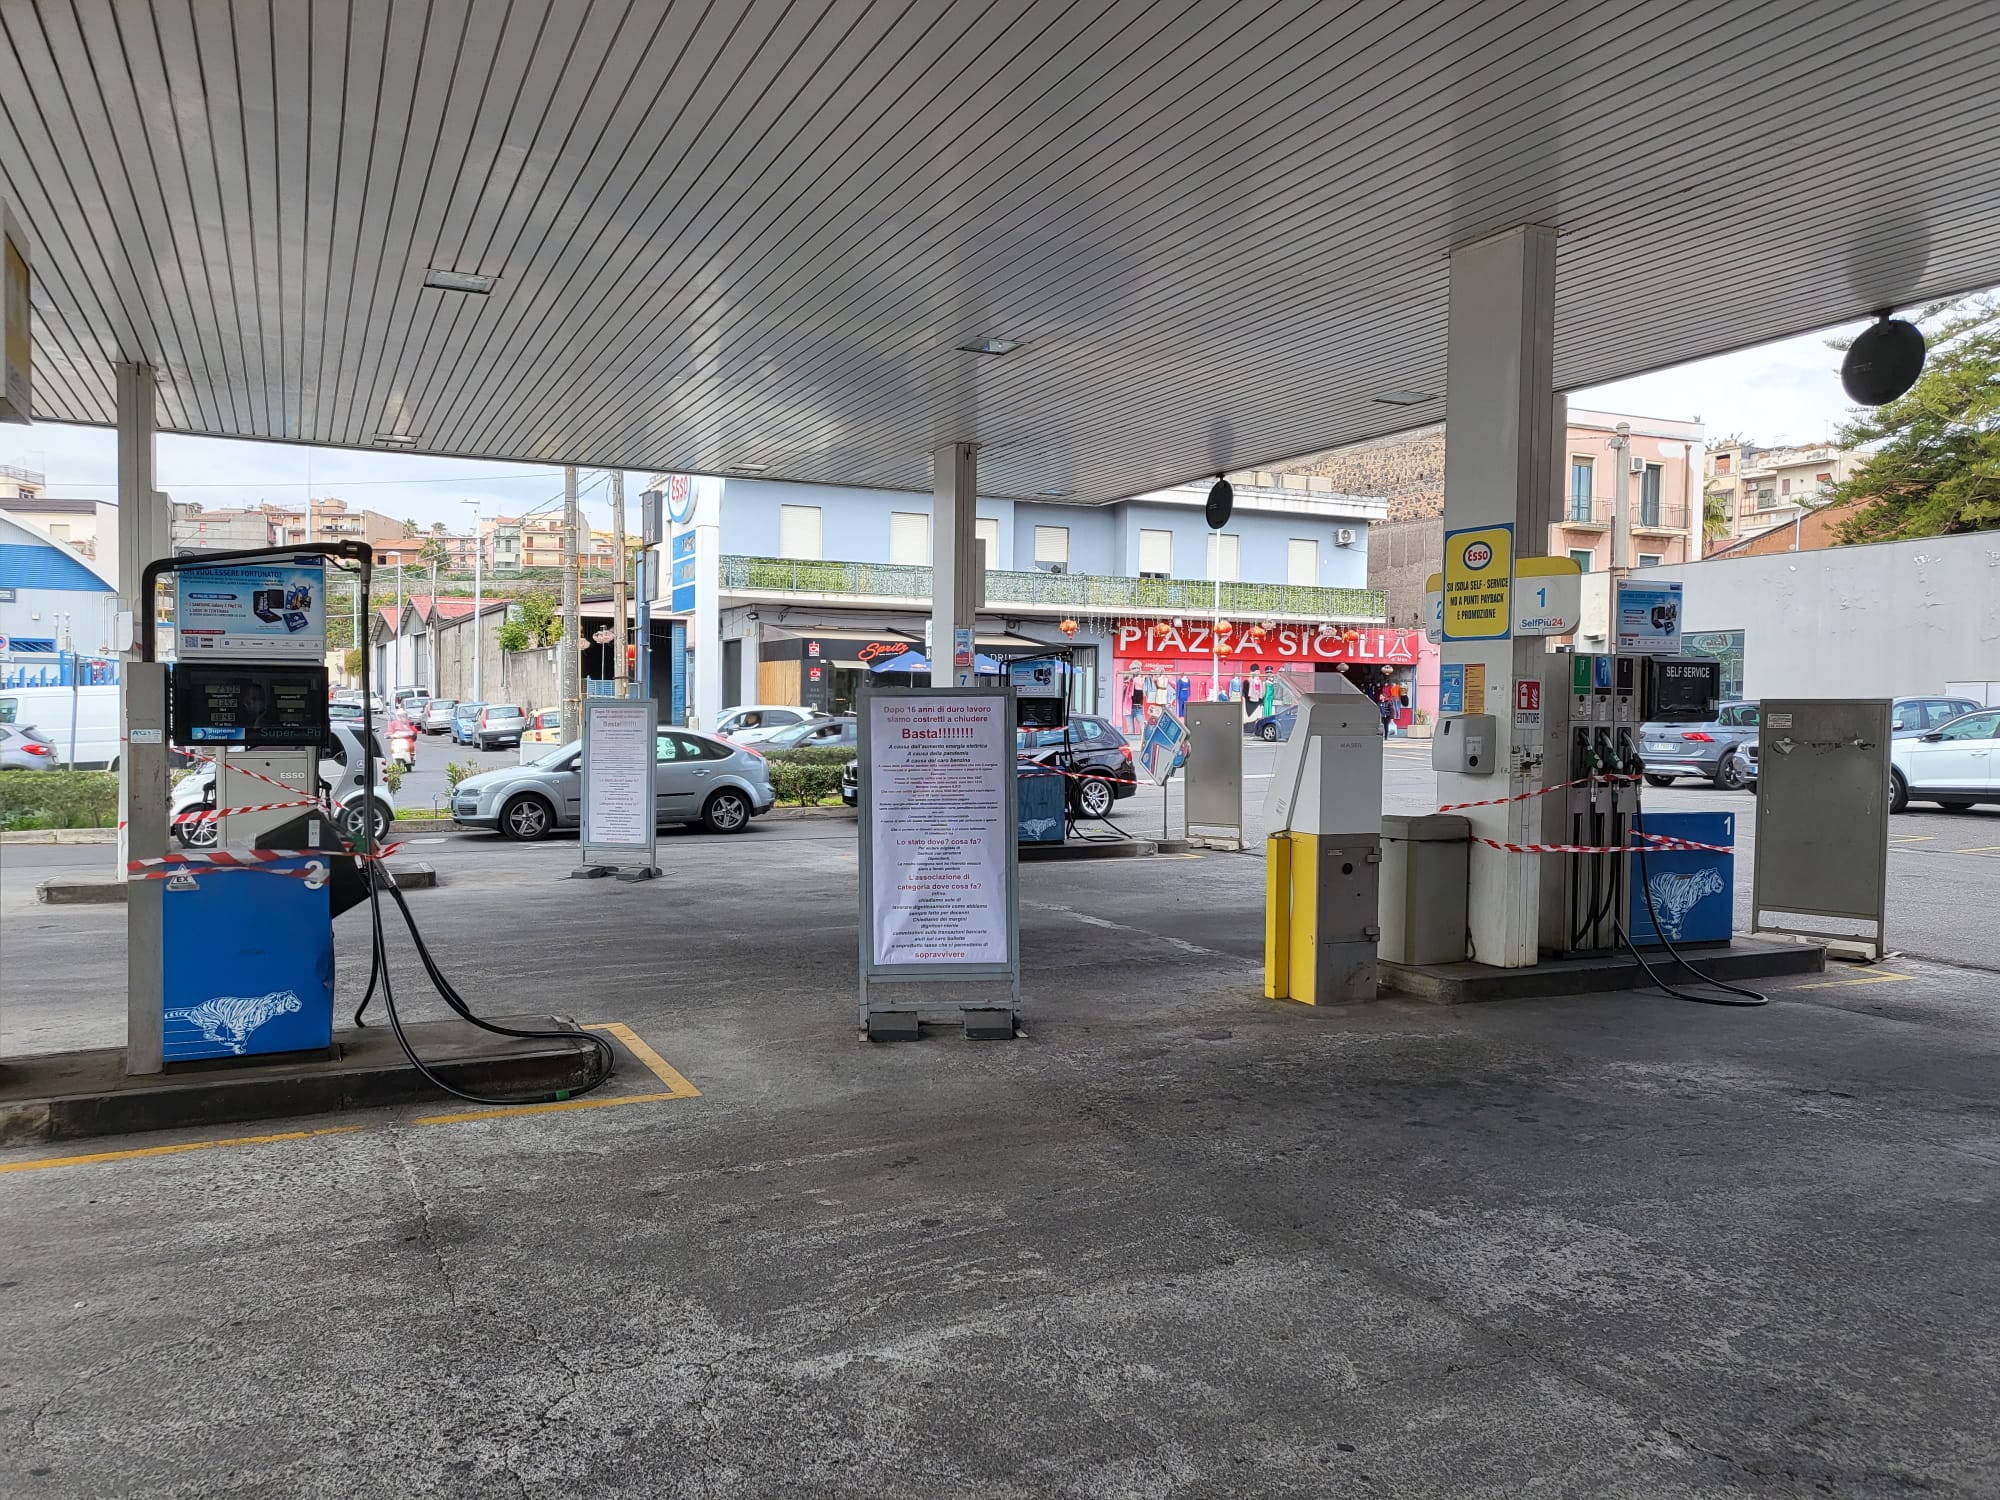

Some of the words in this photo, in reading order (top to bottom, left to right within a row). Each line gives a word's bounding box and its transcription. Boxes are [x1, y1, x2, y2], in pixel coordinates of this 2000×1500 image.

[1468, 550, 1488, 562] Esso
[1446, 582, 1454, 592] SU
[1454, 580, 1469, 592] ISOLA
[1470, 580, 1482, 590] SELF
[1487, 578, 1508, 589] SERVICE
[1450, 596, 1458, 606] NO
[1458, 596, 1463, 605] A
[1464, 595, 1479, 605] PUNTI
[1480, 593, 1504, 604] PAYBACK
[1536, 587, 1546, 608] 1
[1457, 610, 1460, 620] E
[1462, 608, 1496, 620] PROMOZIONE
[1521, 618, 1563, 628] SelfPiù24
[858, 642, 909, 660] Spritz
[1666, 666, 1683, 678] SELF
[1683, 667, 1710, 678] SERVICE
[960, 675, 967, 686] 7
[884, 706, 905, 714] Dopo
[937, 705, 945, 713] di
[946, 705, 965, 713] duro
[913, 715, 946, 723] costretti
[1517, 713, 1540, 724] ESTINTORE
[1723, 816, 1732, 836] 1
[915, 951, 965, 960] sopravvivere
